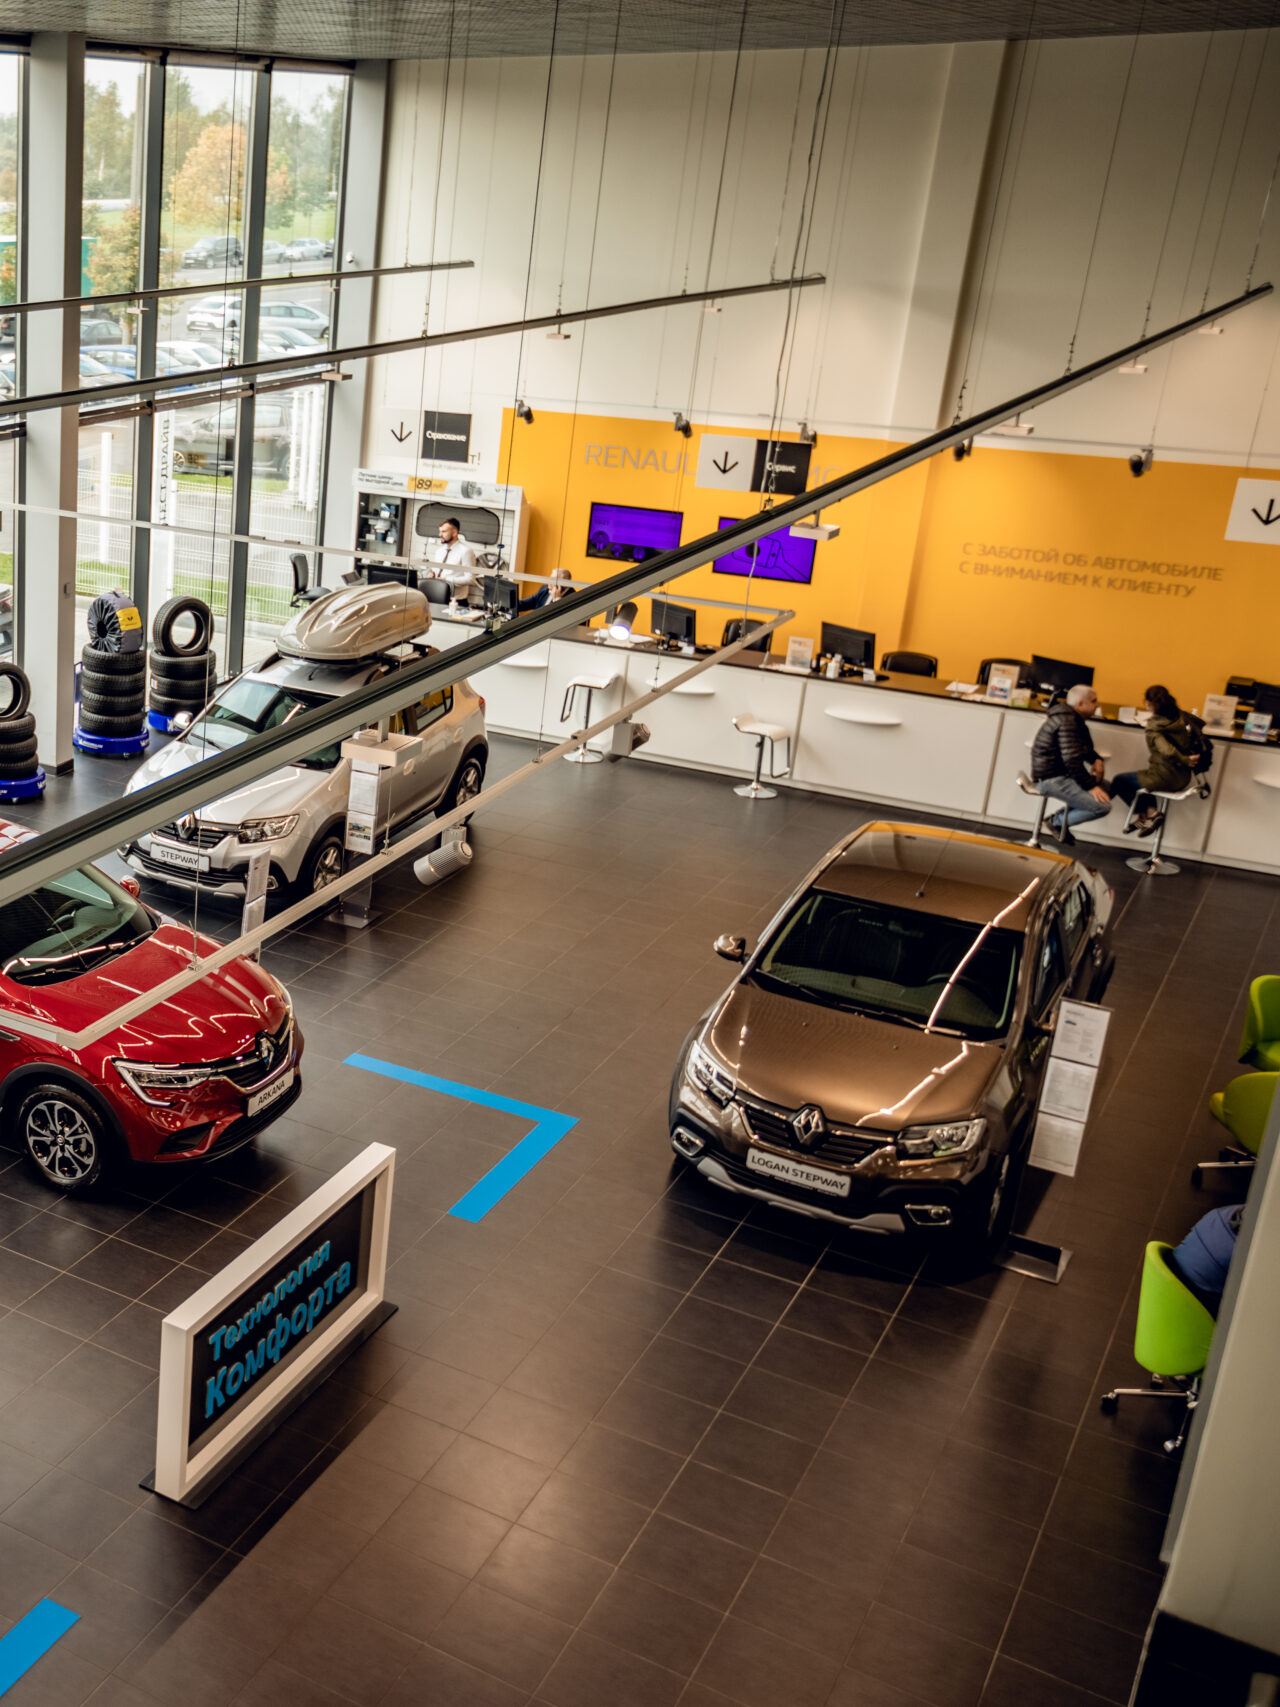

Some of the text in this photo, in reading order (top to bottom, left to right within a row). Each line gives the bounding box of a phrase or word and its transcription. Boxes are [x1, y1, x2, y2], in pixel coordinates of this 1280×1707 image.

[425, 430, 467, 442] Страхование
[584, 443, 696, 476] RENAUL
[416, 478, 432, 490] 89
[962, 542, 1224, 582] С ЗАБОТОЙ ОБ АВТОМОБИЛЕ
[959, 561, 1196, 599] С ВНИМАНИЕМ К КЛИЕНТУ
[161, 850, 199, 866] STEPWAY
[257, 1080, 285, 1106] ARKANA
[751, 1155, 846, 1190] LOGAN STEPWAY
[208, 1240, 331, 1361] Технология
[205, 1261, 352, 1419] Комфорта
